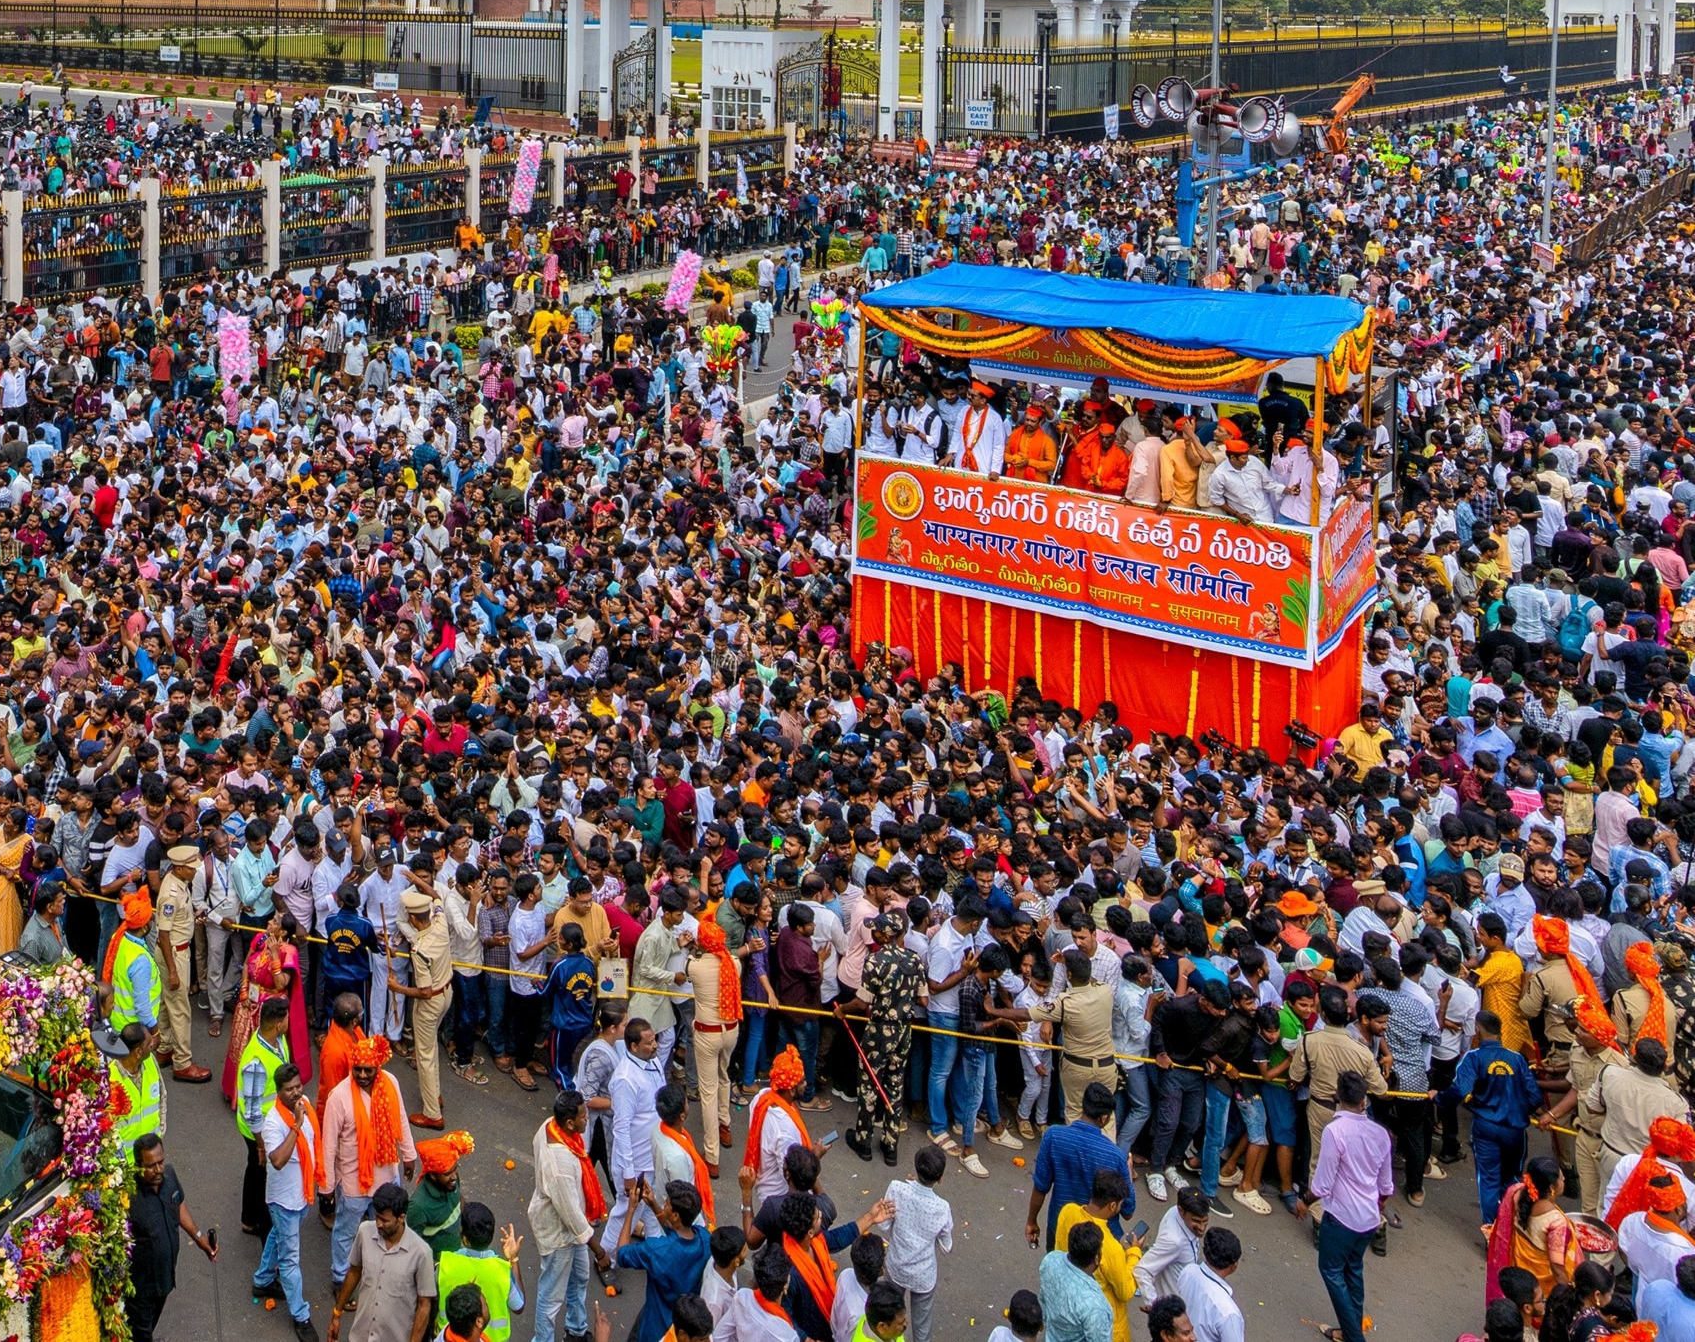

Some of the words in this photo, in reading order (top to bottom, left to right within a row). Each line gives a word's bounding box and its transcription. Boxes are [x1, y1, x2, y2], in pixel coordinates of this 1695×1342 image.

[967, 105, 992, 113] SOUTH
[1132, 99, 1151, 126] SOUND
[1257, 99, 1277, 132] MASTER
[933, 485, 1048, 525] భాగ్యనగర్
[1055, 500, 1121, 543] గణేష్
[1128, 517, 1203, 560] ఉత్సవ
[1209, 528, 1292, 570] సమితి
[920, 549, 980, 574] స్వాగతం
[998, 564, 1081, 595] సుస్వాగతం
[922, 520, 1021, 563] भाग्यनगर
[1023, 535, 1089, 572] गणेश
[1092, 551, 1162, 587] उत्सव
[1165, 562, 1256, 607] समिति
